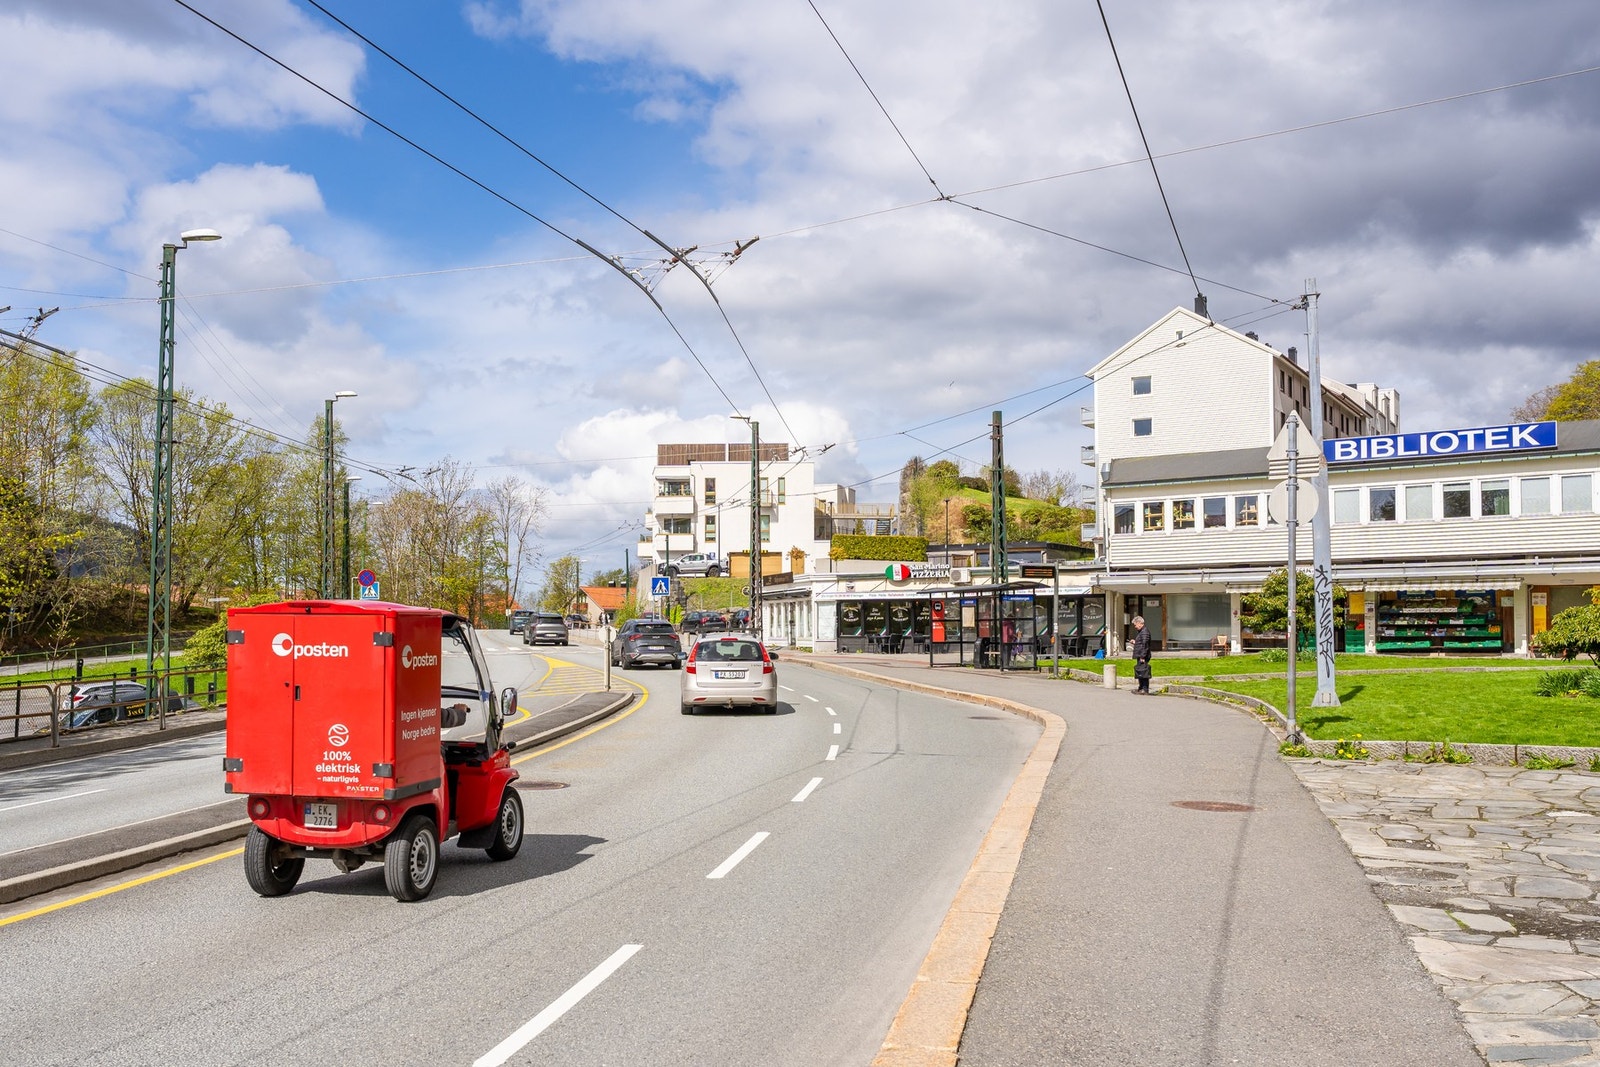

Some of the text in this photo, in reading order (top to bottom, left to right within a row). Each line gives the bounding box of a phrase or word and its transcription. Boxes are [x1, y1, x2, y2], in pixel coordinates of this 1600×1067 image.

[1334, 424, 1540, 461] BIBLIOTEK
[910, 569, 950, 579] PIZZERIA
[293, 642, 349, 660] posten
[412, 653, 438, 670] posten
[401, 708, 437, 723] Ingen kjenner
[402, 725, 436, 741] Norge bedre
[323, 751, 352, 761] 100%
[315, 763, 361, 773] elektrisk
[322, 775, 359, 784] naturligvis
[346, 784, 380, 793] PAXSTER
[318, 805, 328, 815] EK
[313, 816, 333, 826] 2776
